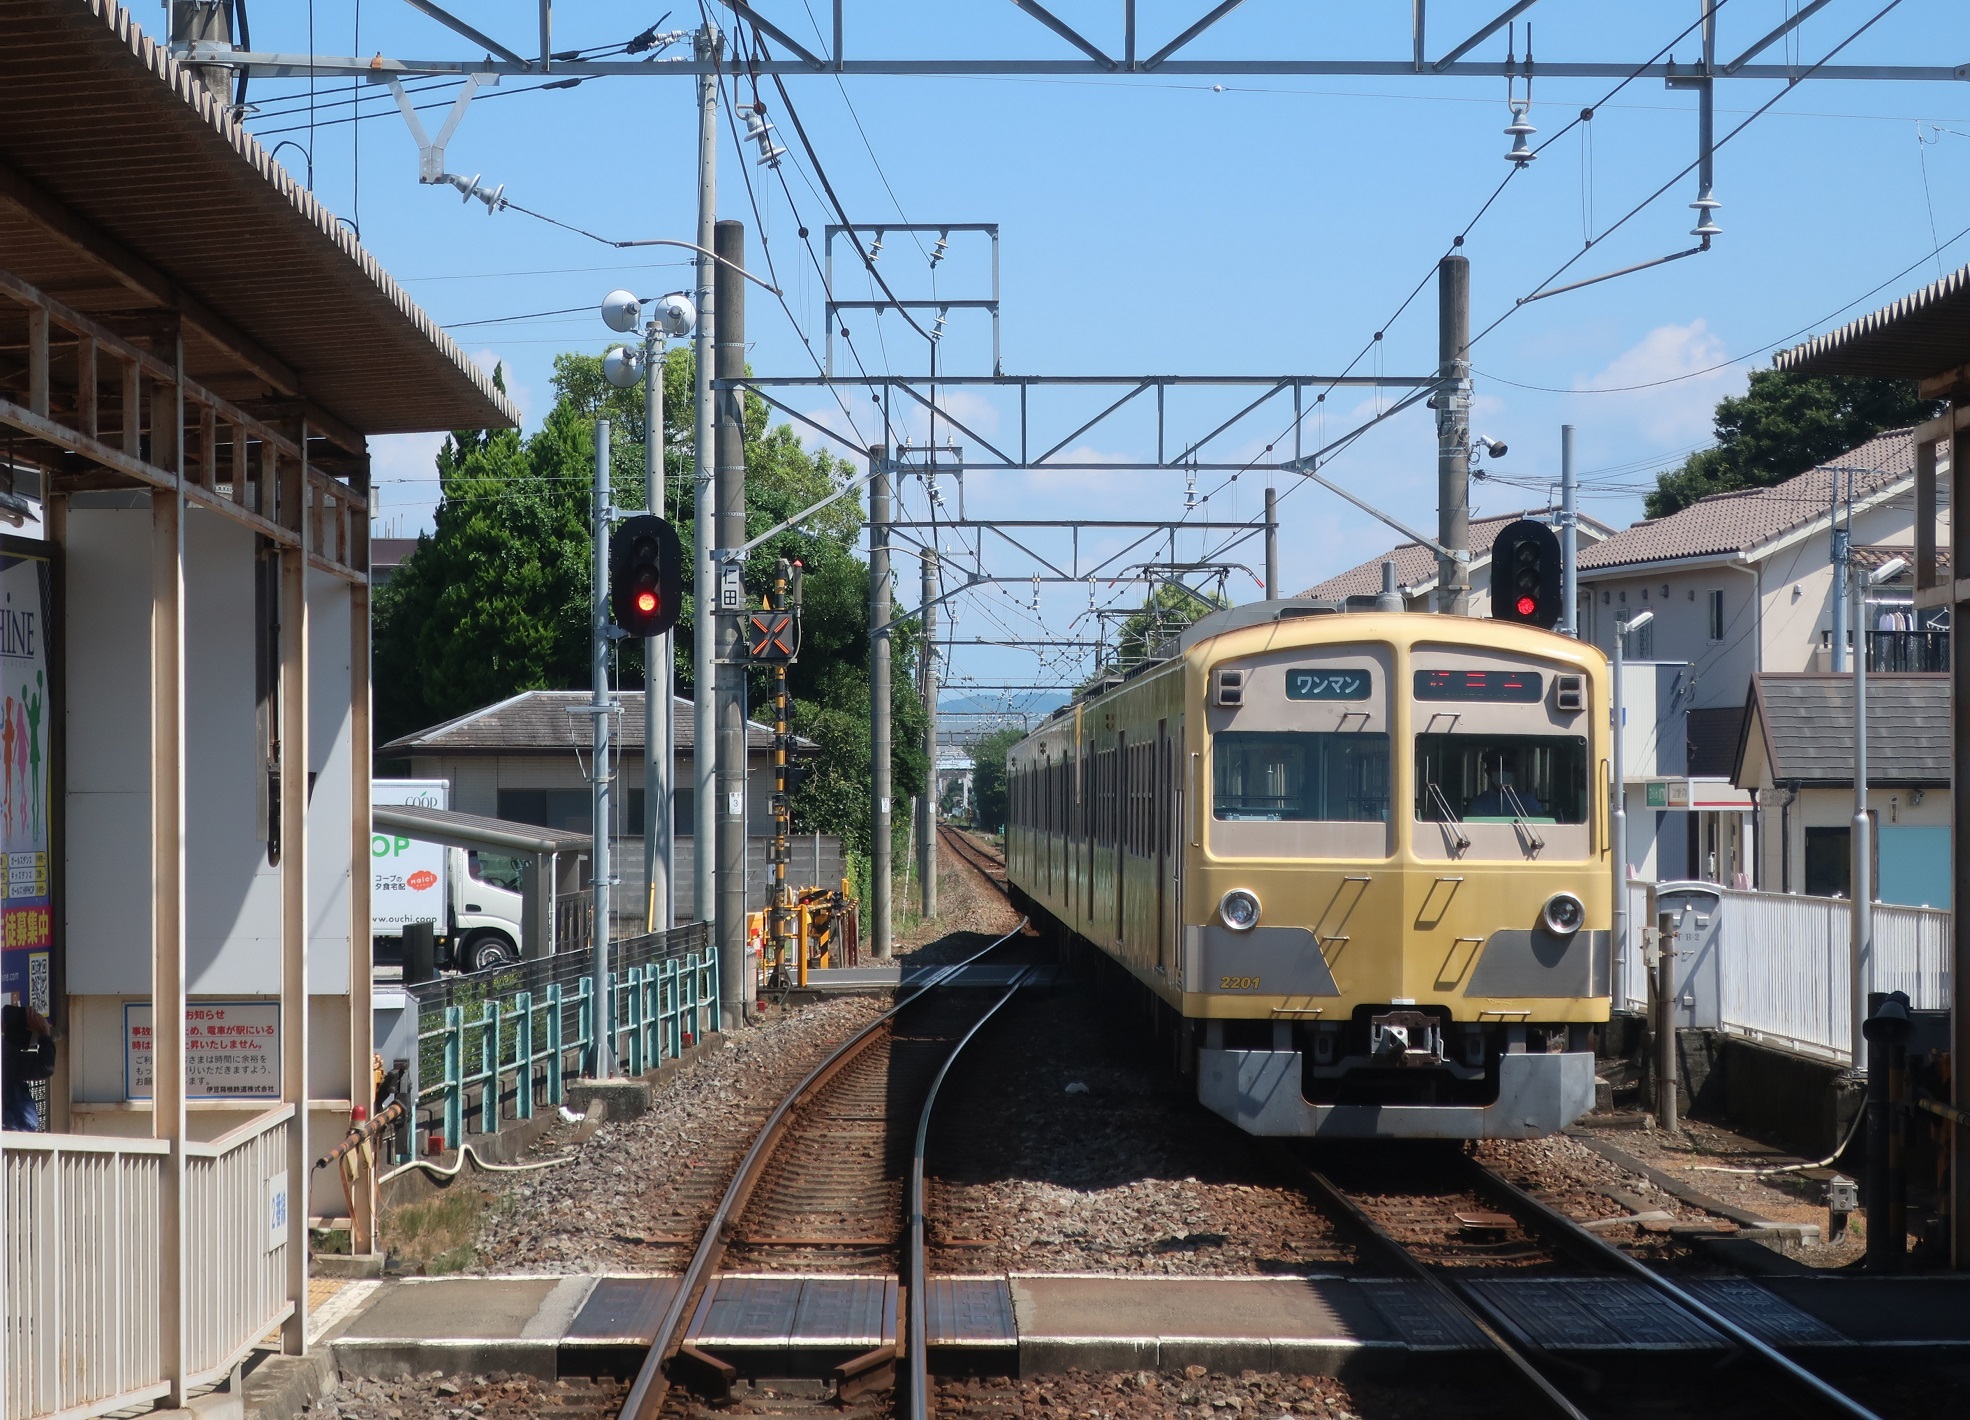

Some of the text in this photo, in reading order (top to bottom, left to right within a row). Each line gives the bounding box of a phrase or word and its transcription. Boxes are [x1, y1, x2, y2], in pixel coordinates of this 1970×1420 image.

[1297, 676, 1360, 694] ワンマン
[375, 882, 406, 891] 夕食宅配
[1220, 976, 1260, 990] 2201
